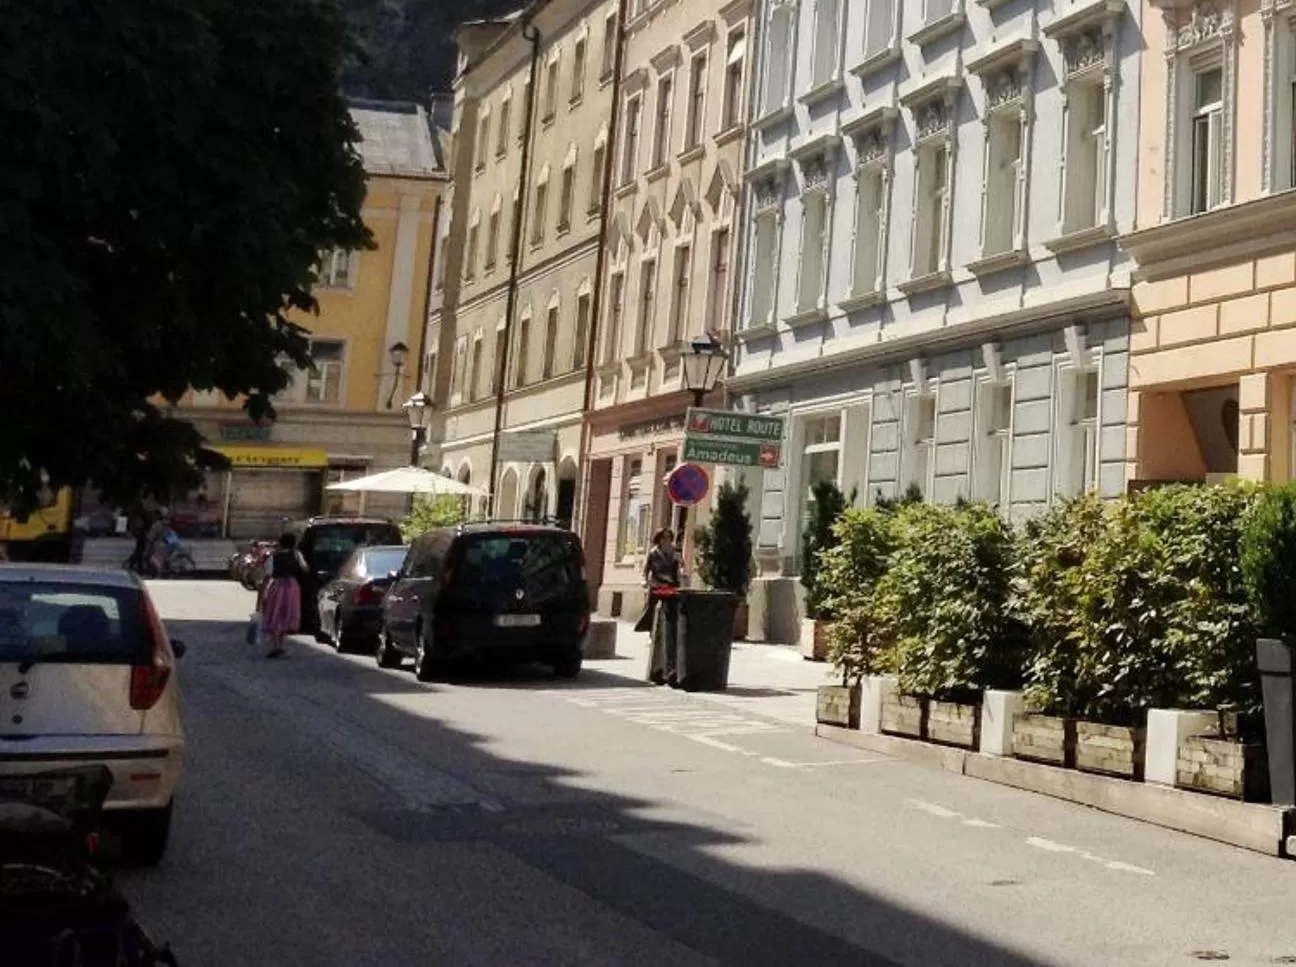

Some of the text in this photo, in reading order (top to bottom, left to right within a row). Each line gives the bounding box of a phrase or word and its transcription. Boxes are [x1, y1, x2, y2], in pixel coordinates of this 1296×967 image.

[711, 416, 782, 436] HOTEL ROUTE
[686, 447, 752, 464] Amadeus
